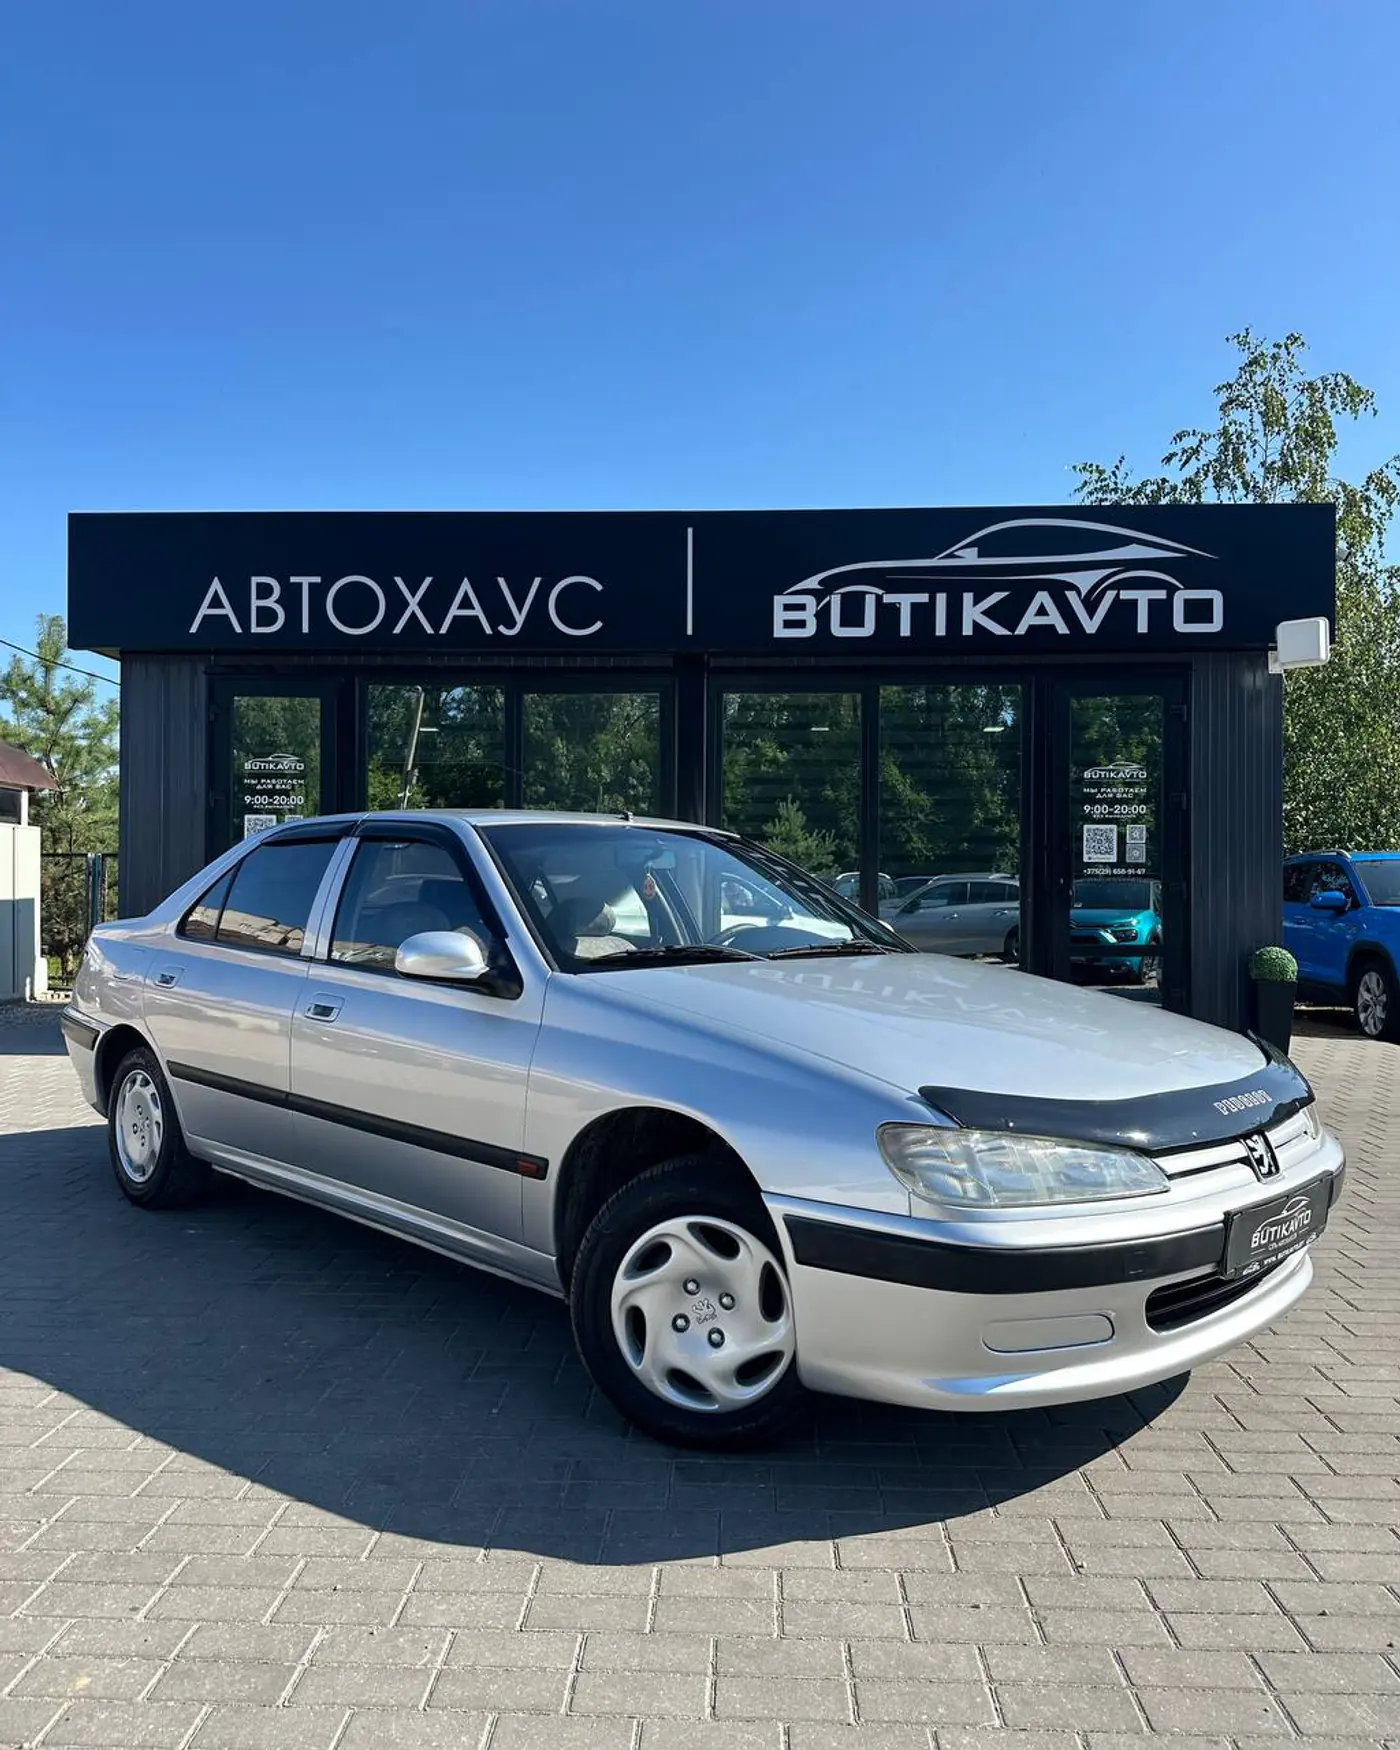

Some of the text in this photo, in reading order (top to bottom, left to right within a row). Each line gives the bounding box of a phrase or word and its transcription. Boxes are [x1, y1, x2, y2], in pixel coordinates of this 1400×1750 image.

[189, 575, 605, 638] АВТОХАУС
[772, 588, 1226, 640] BUTIKAVTO
[244, 761, 305, 770] BUTIKAVTO
[1083, 769, 1147, 778] BUTIKAVTO
[244, 795, 304, 805] 9:00-20:00
[1083, 804, 1147, 815] 9:00-20:00
[1251, 1209, 1312, 1248] BUTIKAVTO
